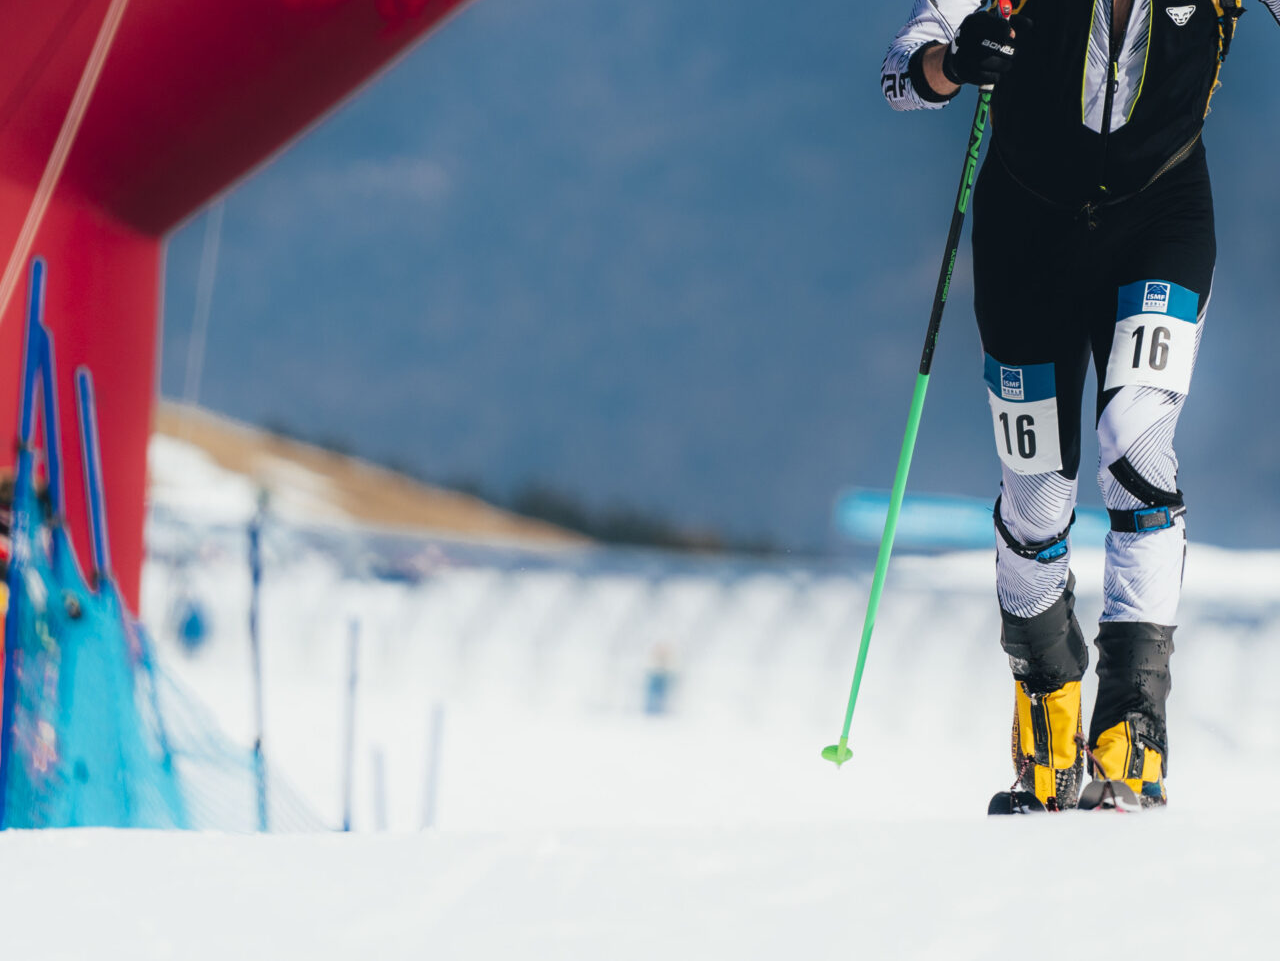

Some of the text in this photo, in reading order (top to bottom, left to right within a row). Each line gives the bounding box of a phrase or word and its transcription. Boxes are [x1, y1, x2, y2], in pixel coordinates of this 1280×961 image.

[1147, 293, 1166, 302] ISMF
[1131, 325, 1171, 371] 16
[1003, 379, 1020, 388] ISMF
[999, 412, 1036, 460] 16
